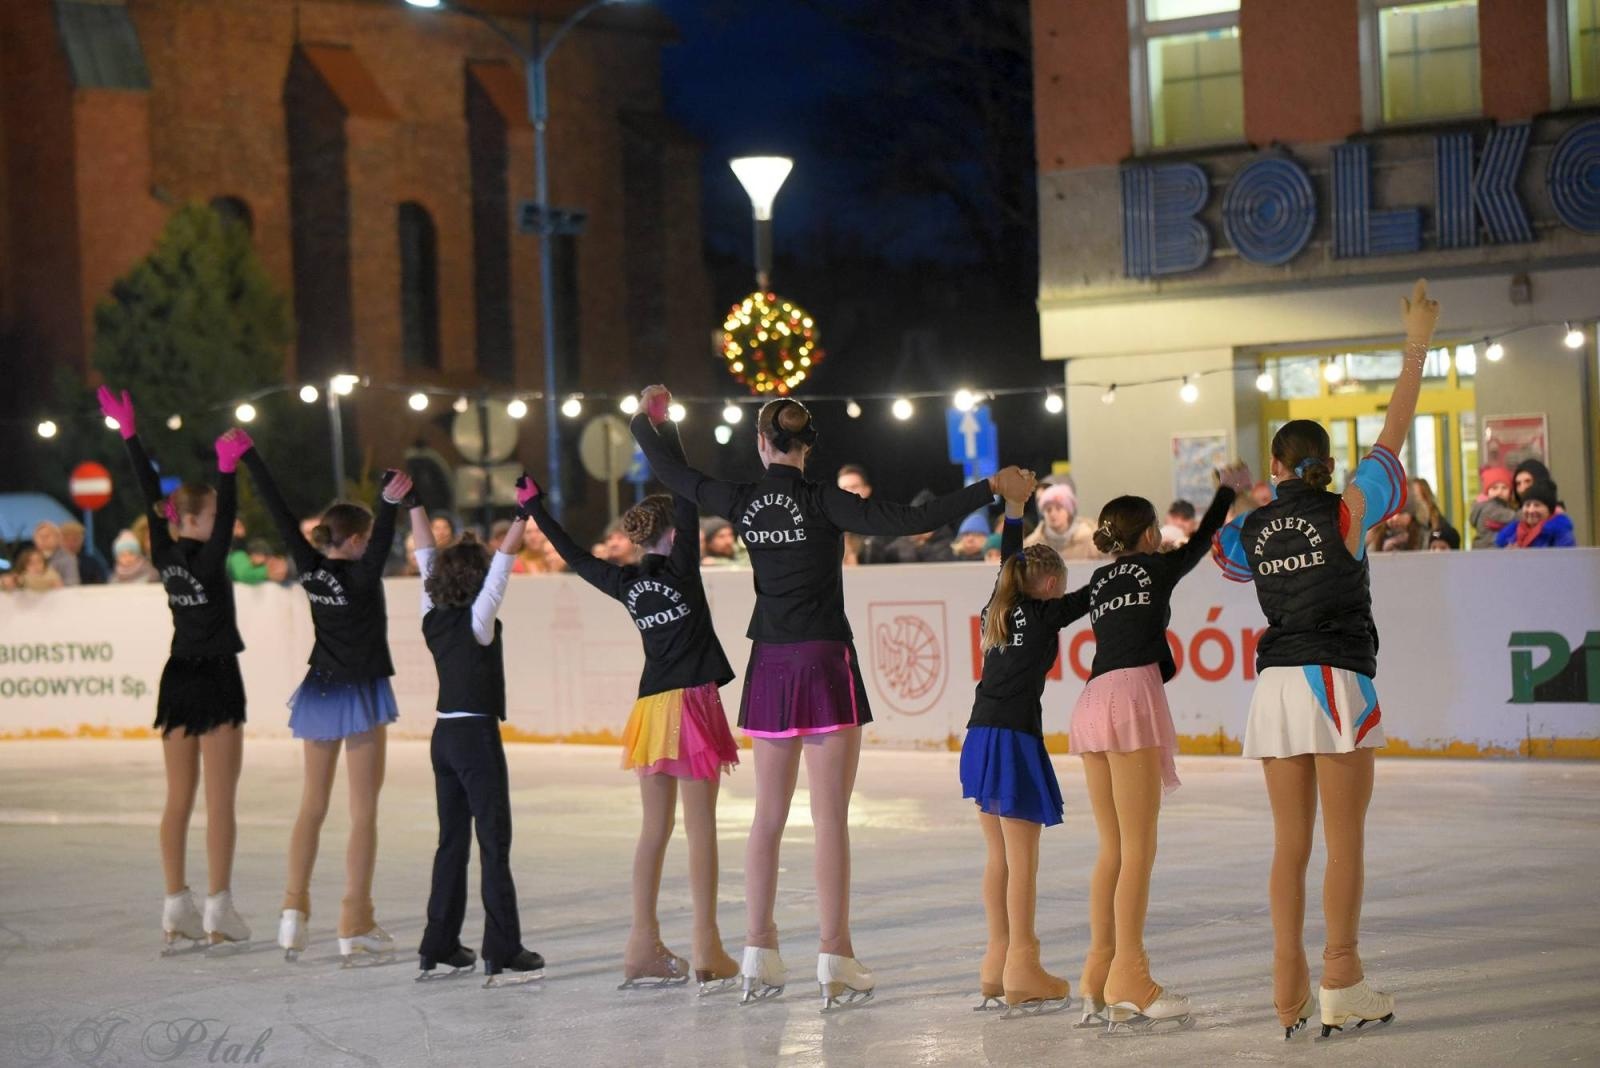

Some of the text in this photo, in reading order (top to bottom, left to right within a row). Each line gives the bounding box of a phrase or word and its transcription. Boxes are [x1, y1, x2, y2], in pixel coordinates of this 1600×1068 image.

[1120, 118, 1600, 279] BOLKO
[742, 494, 803, 526] PIRUETTE
[745, 528, 807, 543] OPOLE
[1254, 517, 1322, 556] PIRUETTE
[1258, 551, 1325, 575] OPOLE
[635, 603, 691, 630] OPOLE
[1091, 591, 1151, 624] OPOLE
